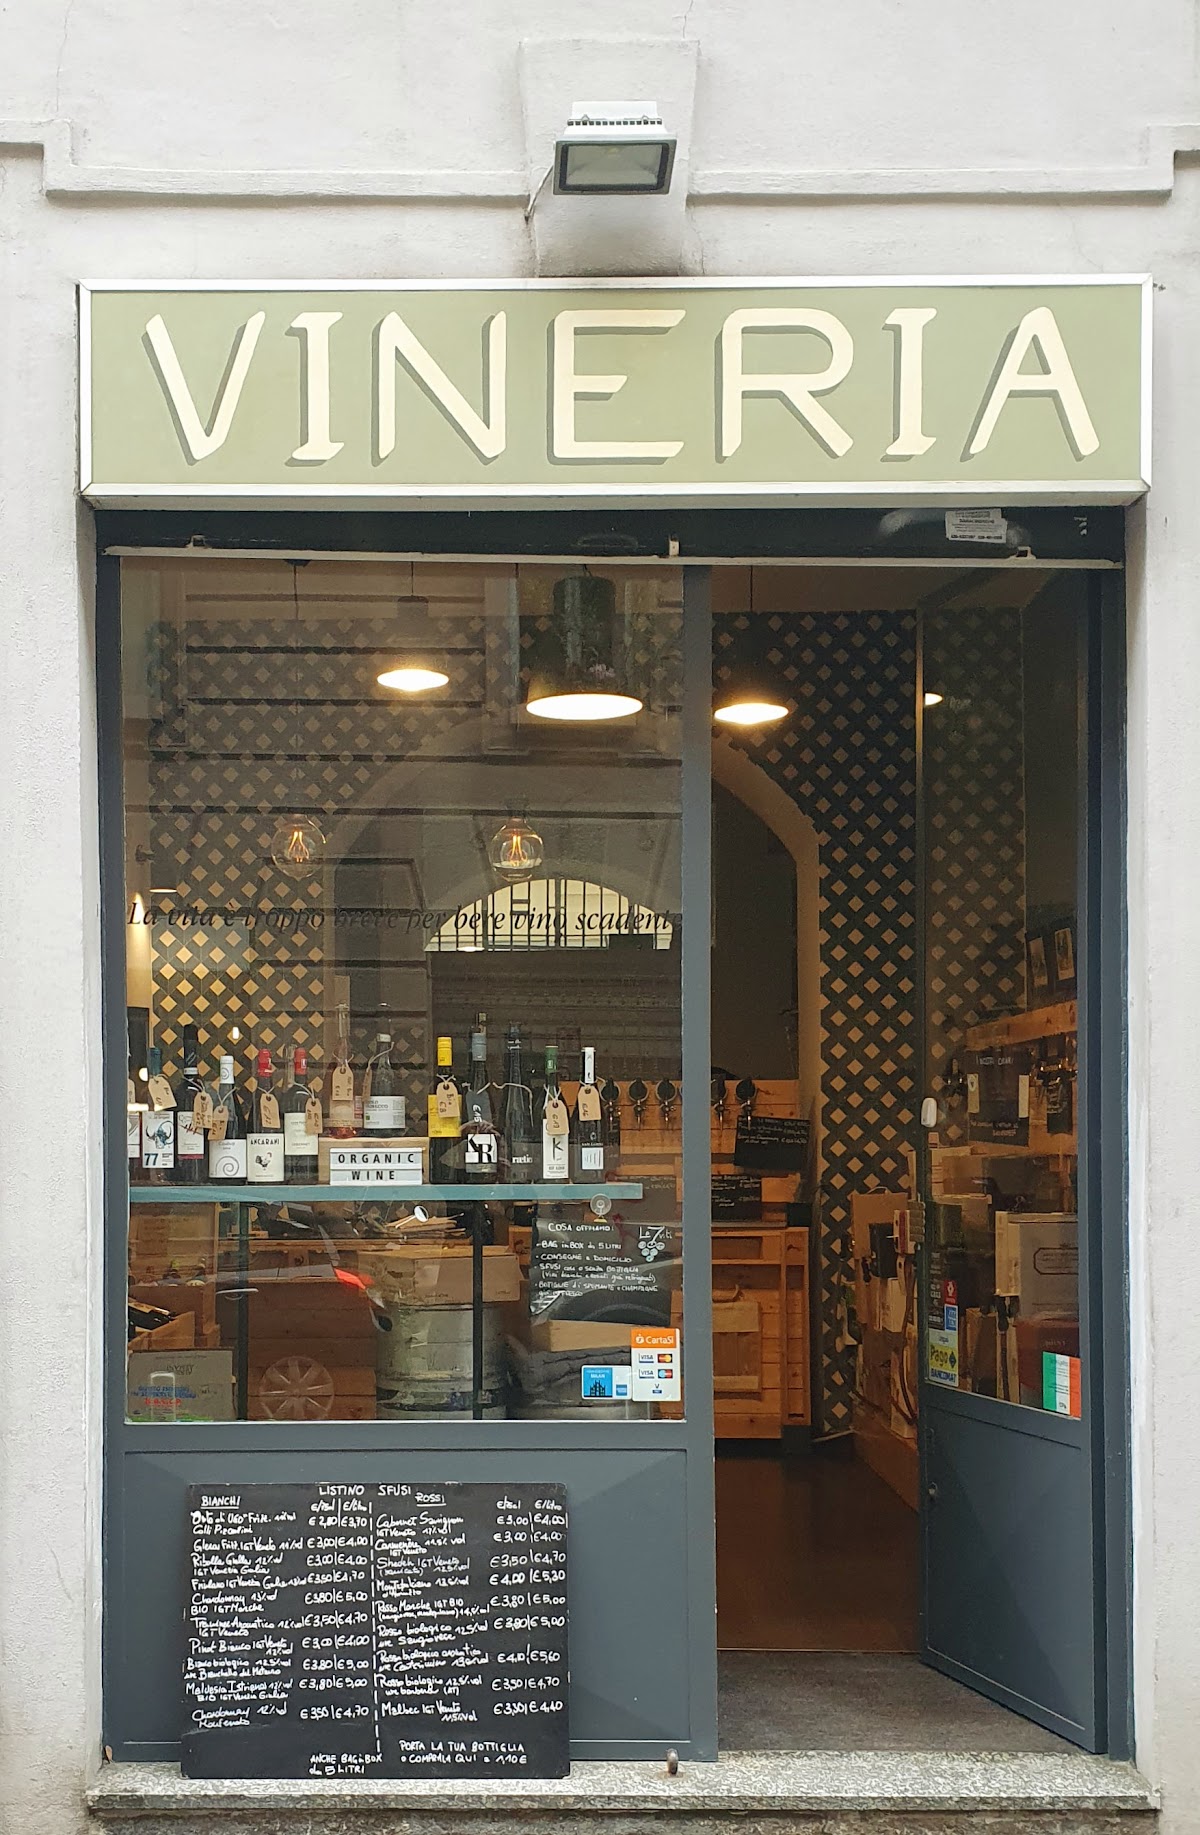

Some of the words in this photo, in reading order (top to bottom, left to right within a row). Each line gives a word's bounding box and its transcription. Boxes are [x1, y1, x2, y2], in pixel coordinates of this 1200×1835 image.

[141, 306, 1100, 466] VINERIA
[127, 902, 158, 926] La
[168, 904, 216, 926] vita
[224, 901, 237, 926] è
[243, 904, 325, 934] troppo
[405, 909, 448, 934] per
[454, 904, 506, 930] bere
[513, 906, 566, 930] vino
[144, 1153, 159, 1166] 77
[338, 1153, 414, 1164] ORGANIC
[351, 1170, 395, 1181] WINE
[548, 1223, 573, 1232] COSA
[570, 1241, 584, 1249] BOX
[930, 1344, 948, 1367] Pago
[318, 1485, 365, 1496] LISTINO
[377, 1484, 411, 1496] SFUSI
[201, 1495, 241, 1509] BIANCHI
[414, 1491, 446, 1507] ROSSI
[375, 1513, 418, 1528] Cabernet
[193, 1524, 212, 1536] Colli
[375, 1529, 390, 1538] IGT
[389, 1527, 417, 1537] Veneto
[450, 1532, 466, 1545] vol
[190, 1552, 225, 1567] Ribolla
[389, 1549, 402, 1557] IGT
[417, 1557, 432, 1568] IGT
[432, 1555, 460, 1566] Veneto
[193, 1568, 209, 1576] IGT
[191, 1590, 246, 1606] Chardonnay
[190, 1604, 209, 1616] BIO
[213, 1605, 229, 1614] IGT
[229, 1602, 265, 1613] Marche
[375, 1600, 398, 1613] Rosso
[398, 1599, 431, 1612] Marche
[434, 1600, 449, 1608] IGT
[448, 1597, 464, 1607] BIO
[198, 1628, 218, 1637] IGT
[217, 1627, 250, 1637] Veneto
[377, 1624, 402, 1637] Rosso
[406, 1622, 452, 1635] biologico
[188, 1637, 217, 1655] Pinot
[218, 1639, 252, 1653] Bianco
[252, 1640, 266, 1650] IGT
[376, 1649, 402, 1663] Rosso
[212, 1657, 250, 1670] biologico
[377, 1673, 404, 1688] Rosso
[404, 1673, 444, 1687] biologico
[196, 1694, 217, 1702] BIO
[219, 1693, 233, 1701] IGT
[381, 1701, 420, 1717] Malbec
[421, 1703, 436, 1714] IGT
[398, 1740, 426, 1752] PORTA
[430, 1740, 444, 1752] LA
[447, 1740, 467, 1752] TUA
[471, 1740, 525, 1753] BOTTIGLIA
[309, 1752, 337, 1765] ANCHE
[340, 1752, 358, 1765] BAG
[364, 1752, 383, 1765] BOX
[454, 1753, 477, 1763] QUI
[324, 1765, 336, 1776] 5
[337, 1763, 365, 1775] LITRI
